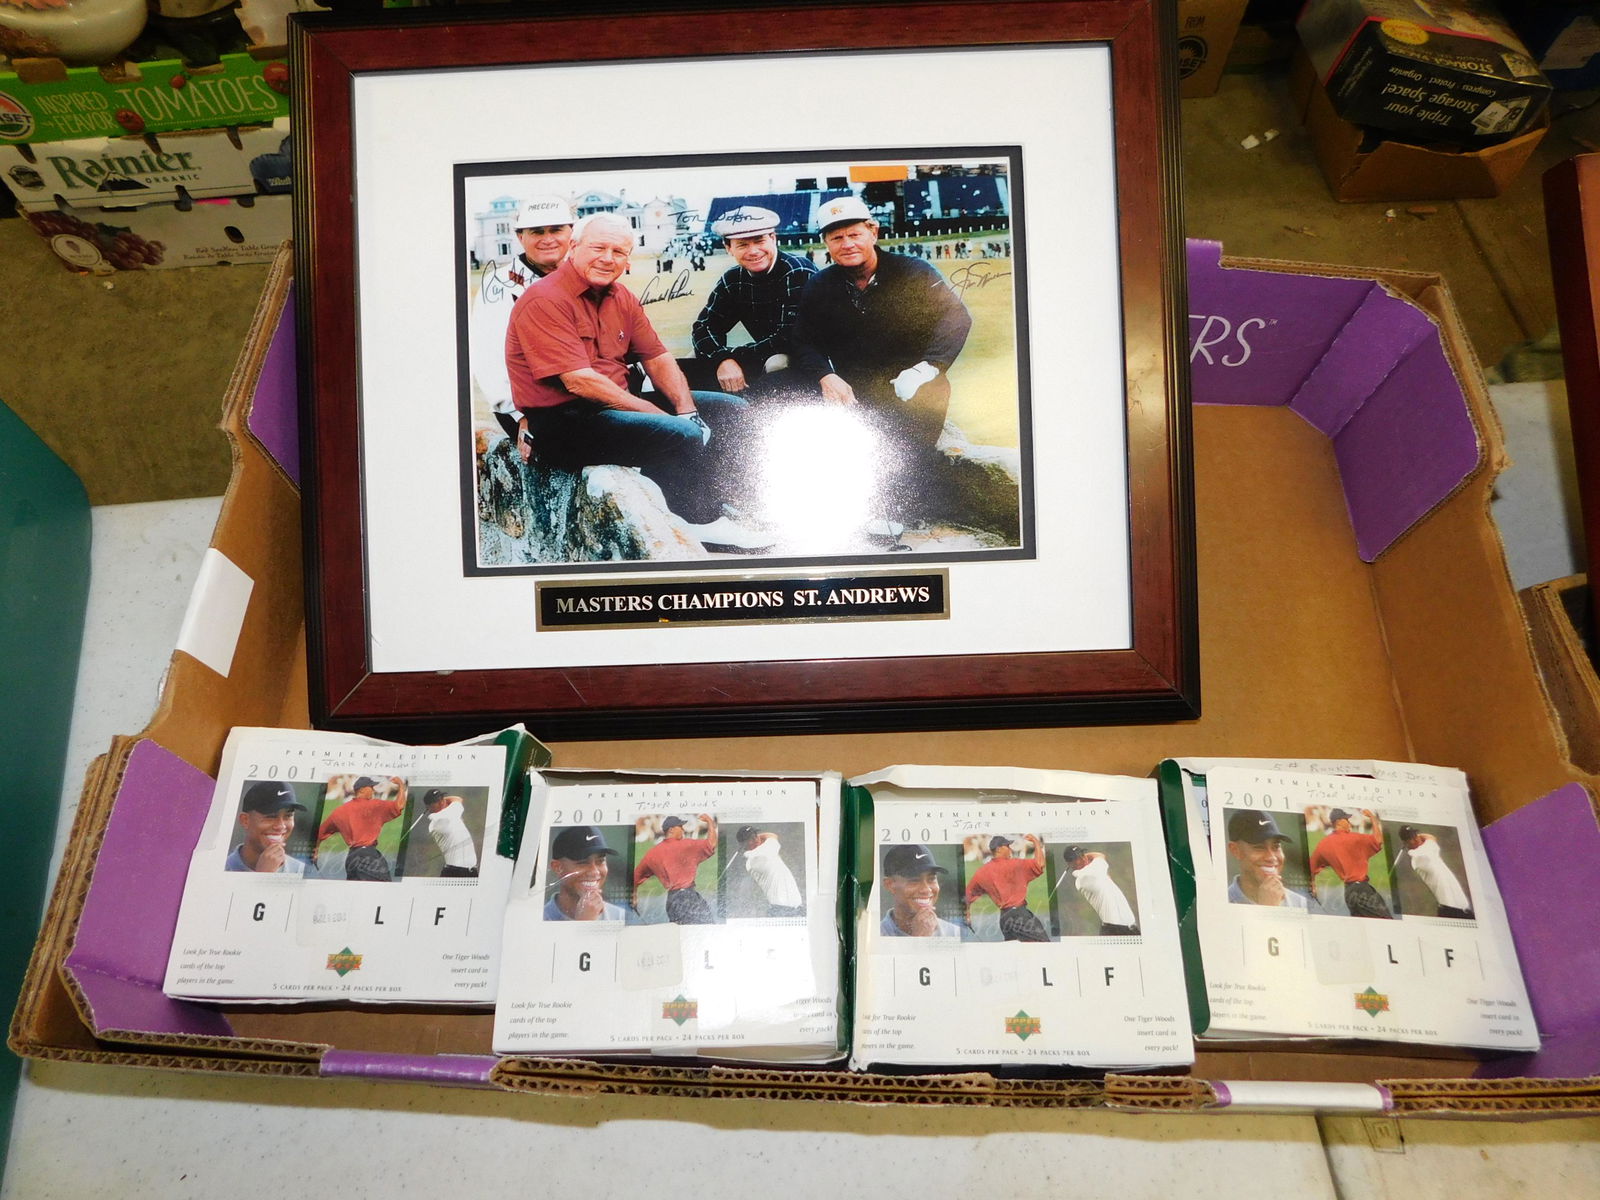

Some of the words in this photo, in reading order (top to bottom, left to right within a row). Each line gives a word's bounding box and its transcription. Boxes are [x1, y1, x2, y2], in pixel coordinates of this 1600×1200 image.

[1388, 66, 1422, 81] Organize
[1429, 77, 1456, 89] Protect
[1462, 84, 1497, 97] Compress
[115, 75, 278, 121] TOMATOES
[1381, 83, 1428, 103] Space!
[33, 91, 109, 115] INSPIRED
[1384, 102, 1418, 114] your
[1429, 93, 1480, 114] Storage
[53, 111, 119, 135] FLAVOR
[1417, 109, 1452, 126] Triple
[46, 150, 193, 188] Rainier
[145, 174, 200, 184] ORGANIC
[556, 595, 654, 614] MASTERS
[657, 590, 784, 611] CHAMPIONS
[793, 589, 822, 607] ST.
[826, 586, 931, 606] ANDREWS
[285, 750, 380, 760] PREMIERE
[399, 753, 477, 761] EDITION
[248, 764, 317, 780] 2001
[587, 790, 684, 799] PREMIERE
[704, 789, 787, 797] EDITION
[1224, 791, 1291, 810] 2001
[553, 808, 621, 824] 2001
[914, 811, 1009, 819] PREMIERE
[1028, 809, 1110, 817] EDITION
[881, 828, 949, 842] 2001
[252, 902, 266, 922] G
[374, 905, 385, 925] L
[434, 906, 446, 926] F
[455, 953, 470, 961] Tiger
[1267, 937, 1279, 957] G
[1387, 944, 1399, 964] L
[1444, 948, 1454, 968] F
[579, 952, 591, 972] G
[918, 967, 931, 986] G
[1042, 967, 1053, 987] L
[1104, 967, 1115, 986] F
[511, 1001, 526, 1009] Look
[509, 1016, 526, 1024] cards
[535, 1016, 545, 1024] the
[508, 1031, 530, 1040] players
[539, 1031, 549, 1039] the
